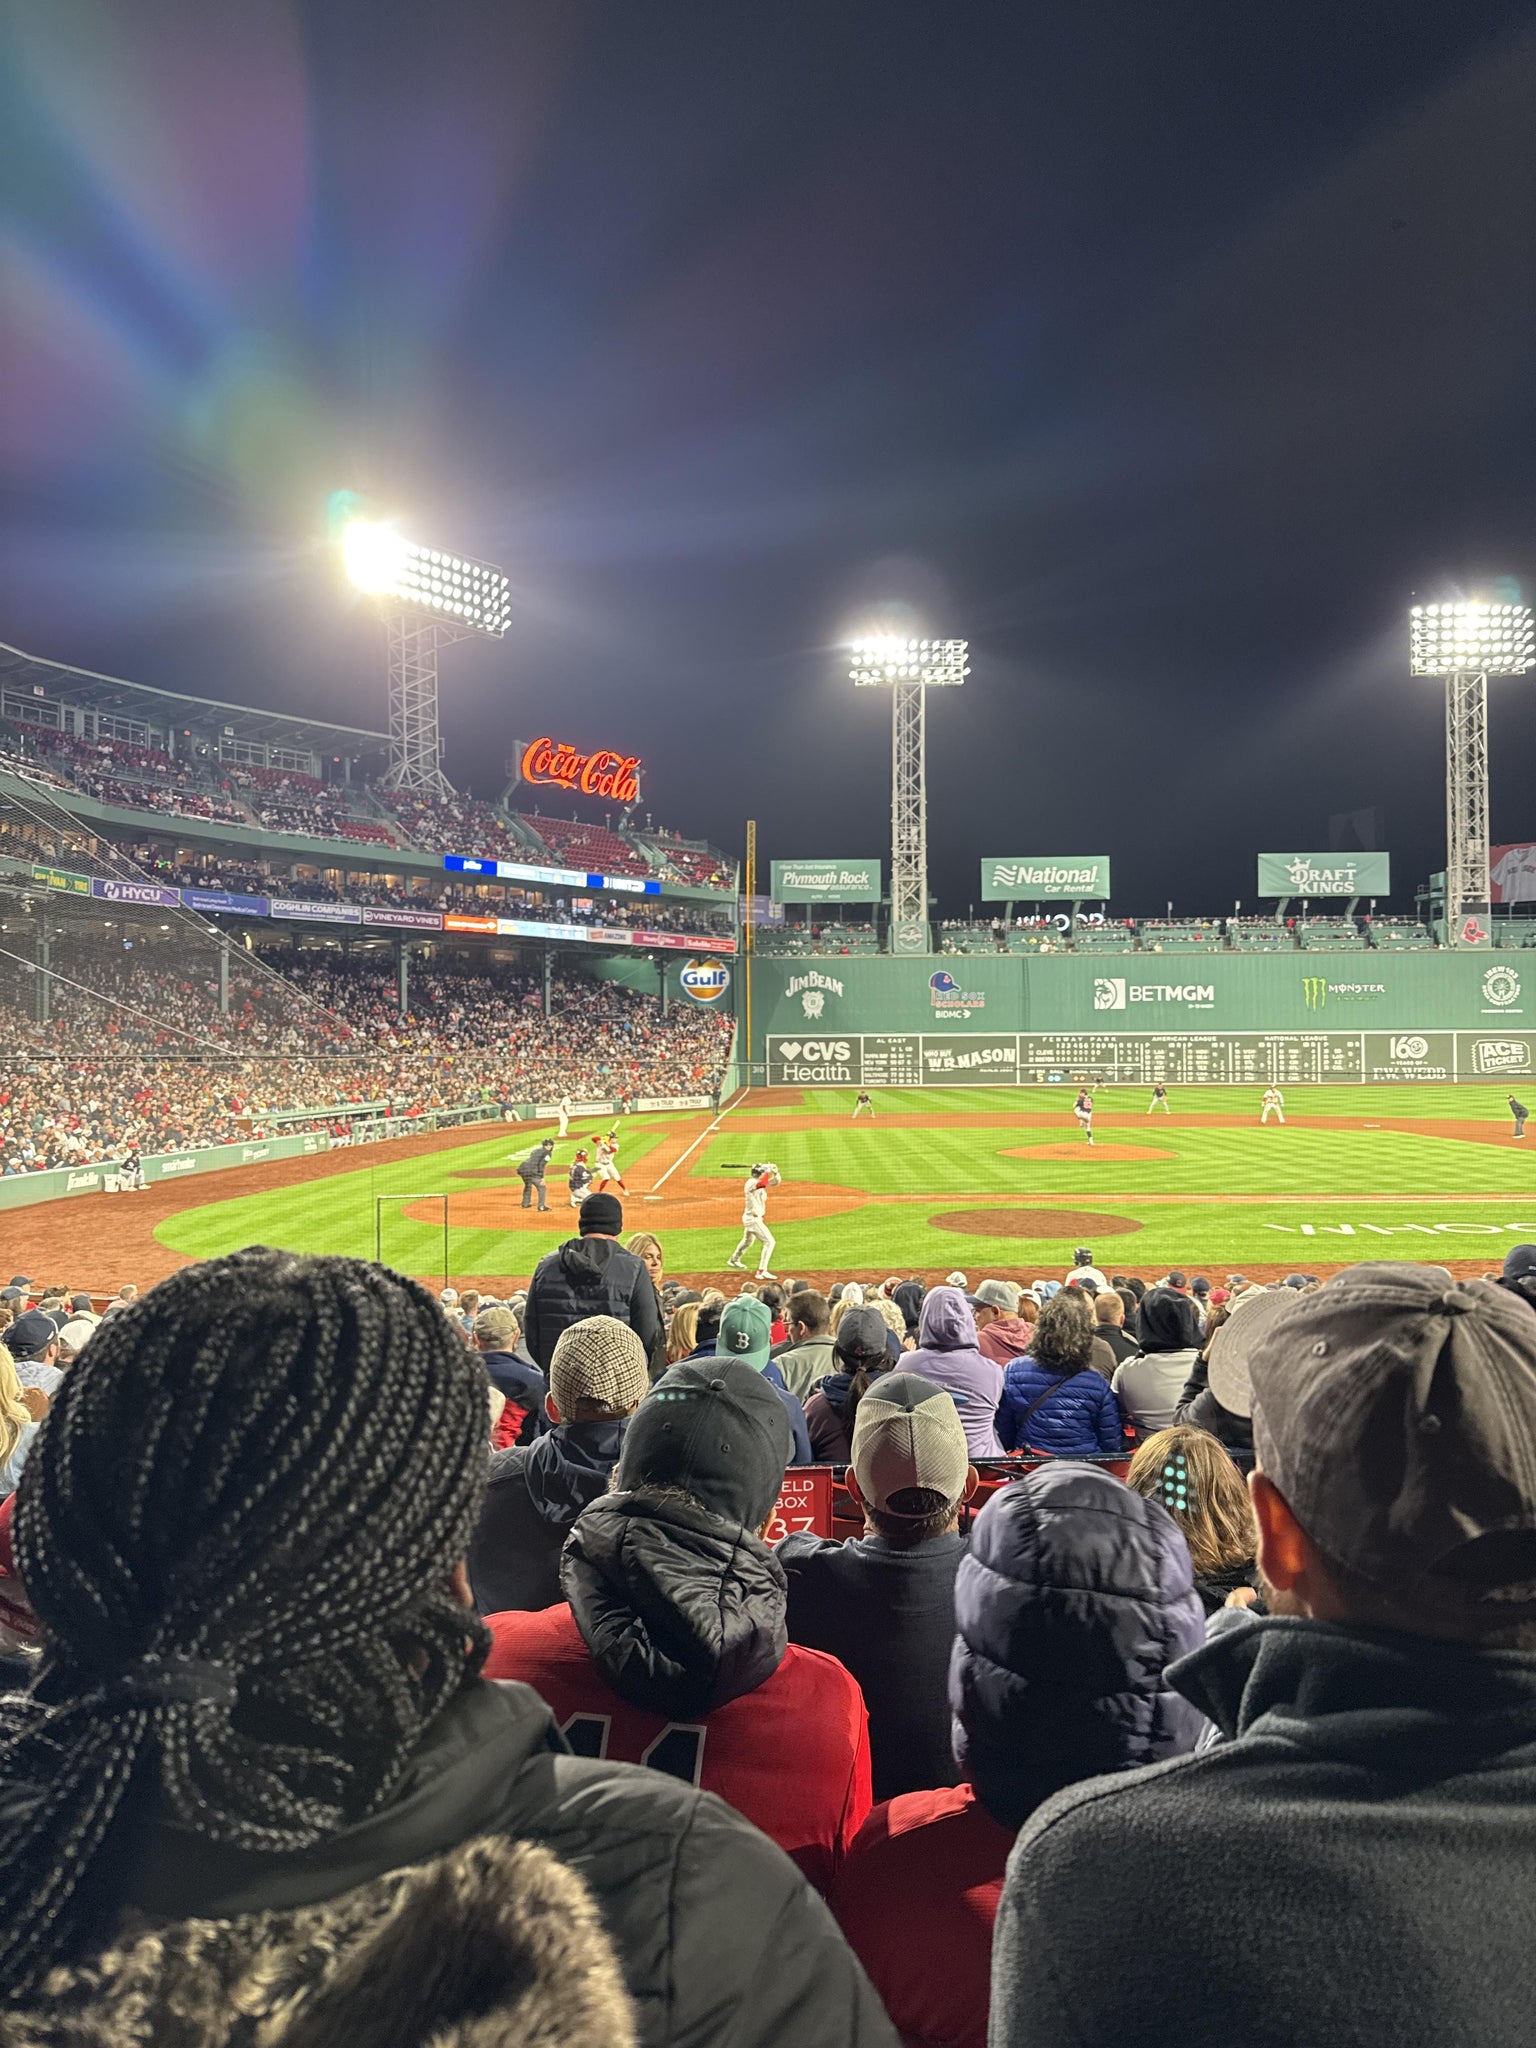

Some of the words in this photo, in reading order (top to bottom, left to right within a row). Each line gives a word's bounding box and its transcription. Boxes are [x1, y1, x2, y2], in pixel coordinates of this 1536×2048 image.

[522, 738, 641, 802] Coca-Cola
[783, 871, 837, 886] Plymouth
[839, 871, 869, 884] Rock
[1017, 866, 1098, 884] National
[1290, 869, 1357, 884] DRAFT
[122, 886, 161, 901] HYCU
[1045, 885, 1061, 893] Car
[1063, 884, 1094, 893] Rental
[1298, 881, 1355, 894] KINGS
[274, 902, 311, 912] COGHLIN
[374, 913, 415, 923] VINEYARD
[683, 971, 726, 985] Gulf
[785, 976, 809, 998] JIM
[809, 971, 845, 998] BEAM
[1129, 985, 1214, 1001] BETMGM
[1328, 984, 1386, 994] MONSTER
[961, 992, 985, 1001] SOX
[935, 1010, 963, 1019] BIDMC
[802, 1041, 851, 1061] CVS
[1390, 1036, 1428, 1059] 160
[1484, 1043, 1524, 1058] ACE
[1484, 1056, 1524, 1068] TICKET
[752, 1066, 765, 1074] 310
[782, 1063, 852, 1081] Health
[1401, 1067, 1447, 1080] WEBB
[1036, 1074, 1044, 1082] 5
[736, 1332, 750, 1350] B
[781, 1480, 814, 1493] ELD
[774, 1496, 808, 1509] BOX
[763, 1516, 815, 1544] 37
